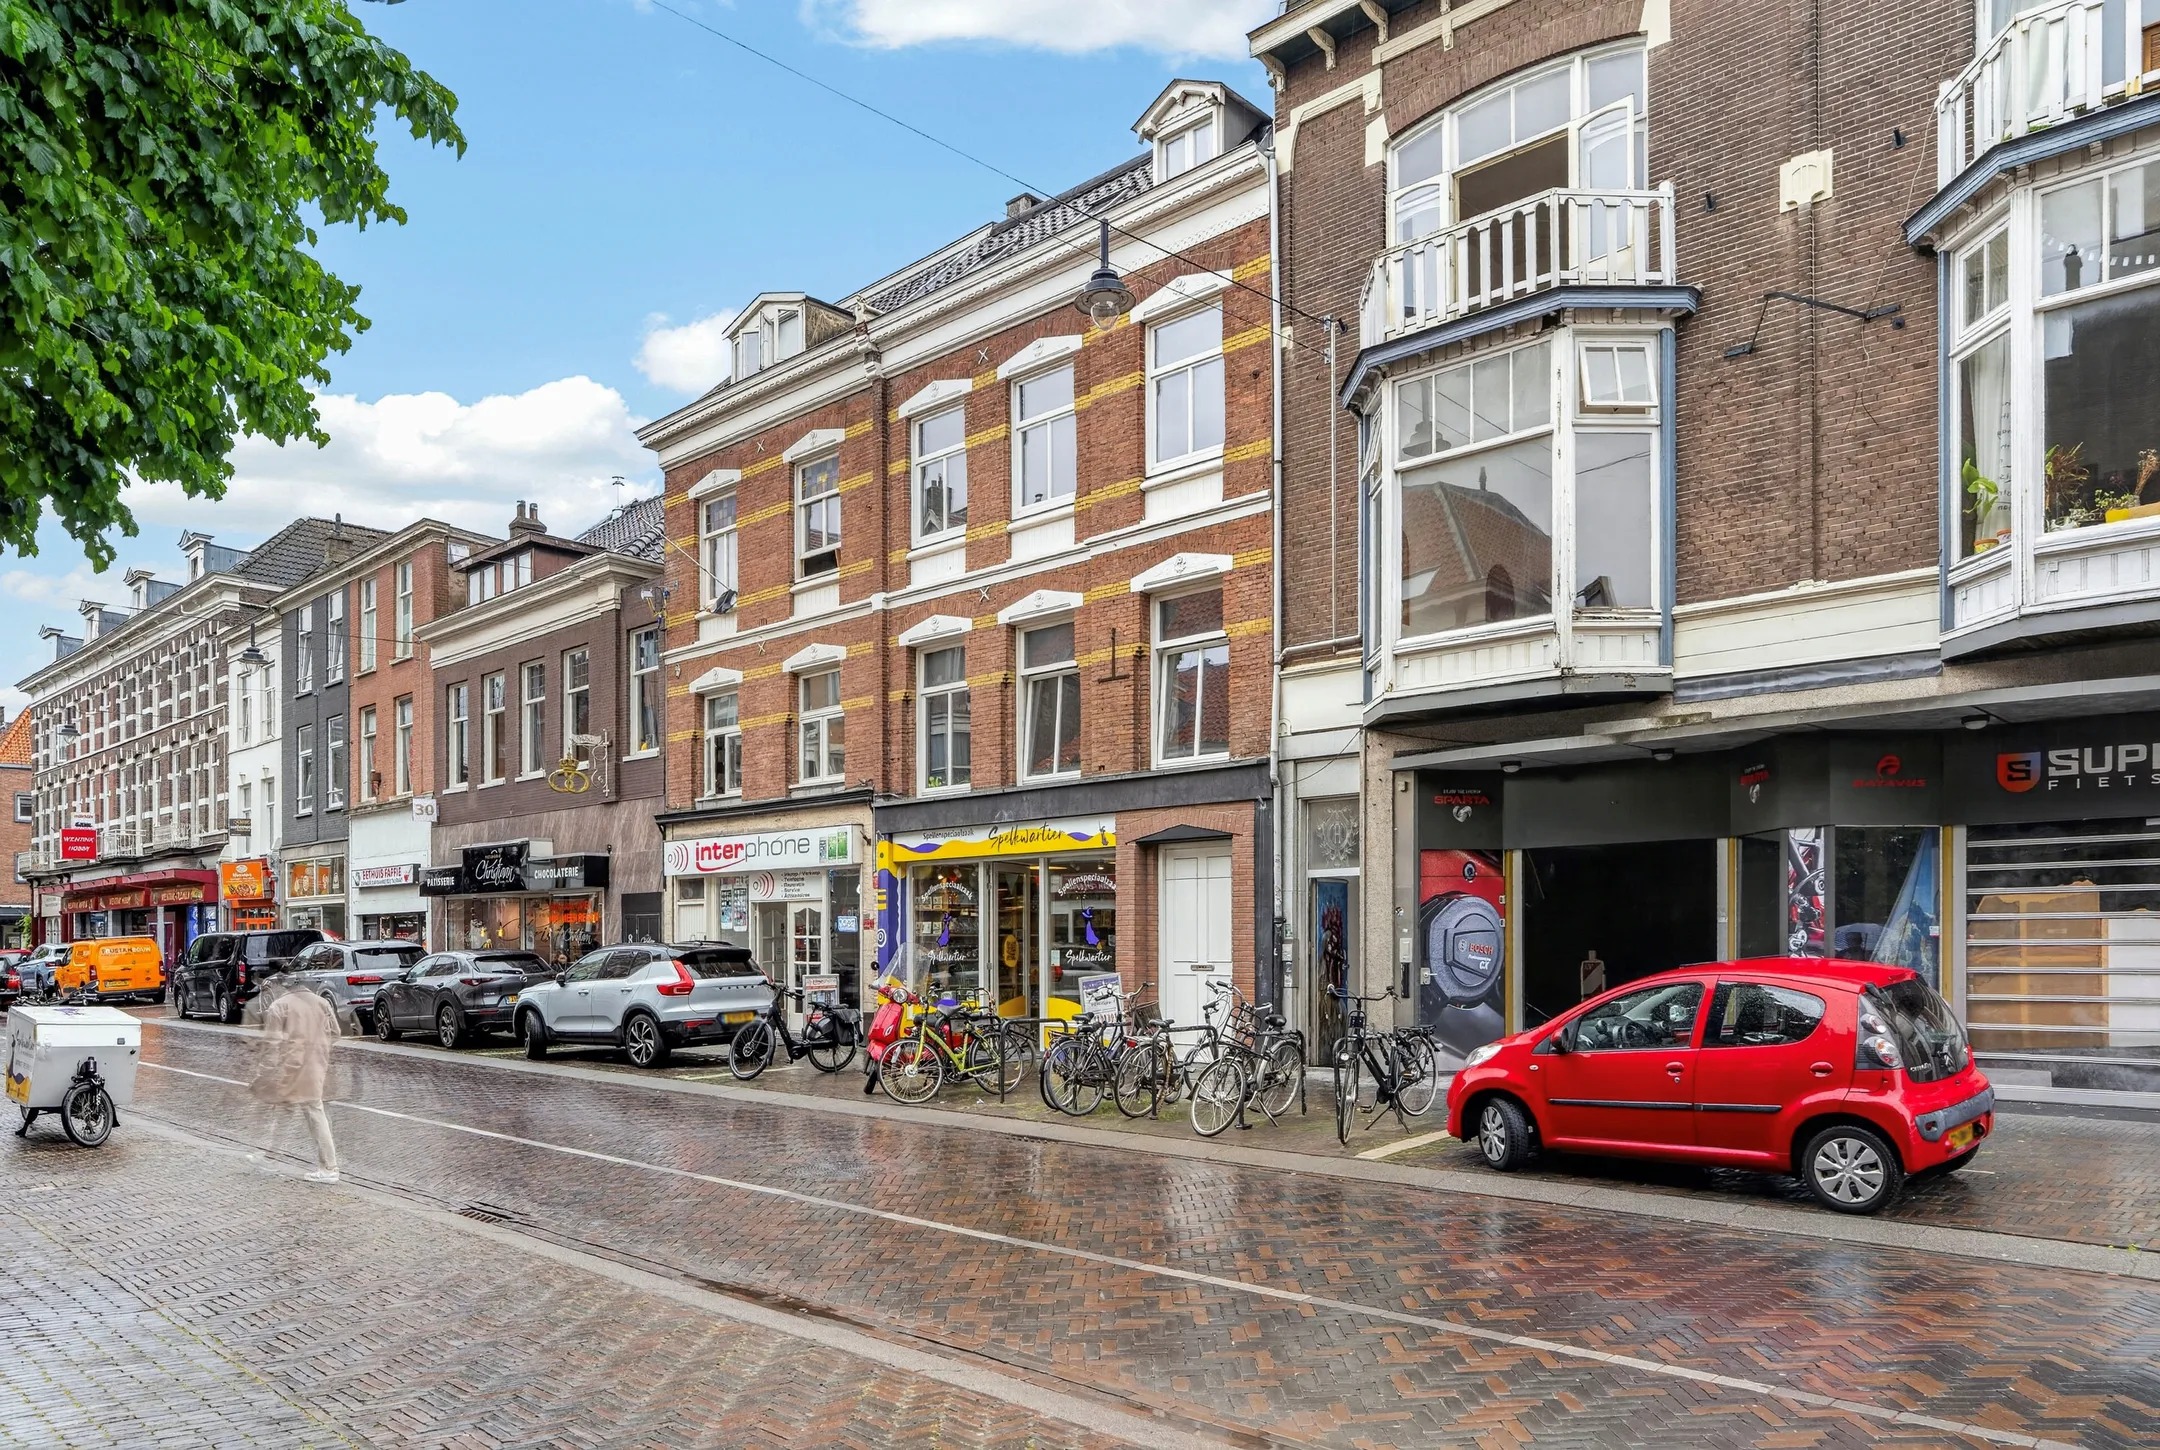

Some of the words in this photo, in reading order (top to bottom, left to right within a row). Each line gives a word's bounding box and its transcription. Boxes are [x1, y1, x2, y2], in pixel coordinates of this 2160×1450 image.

[1434, 795, 1490, 805] SPARTA
[415, 804, 435, 816] 30
[988, 821, 1064, 851] Spelkwartier
[696, 836, 810, 865] interphone
[363, 868, 384, 880] EETHUIS
[534, 866, 579, 879] CHOCOLATERIE
[426, 876, 455, 887] PATISSERIE
[1058, 873, 1117, 896] Spellenspeciaalzaa
[1469, 943, 1493, 955] BOSCH
[1065, 949, 1112, 966] Spelkwartier
